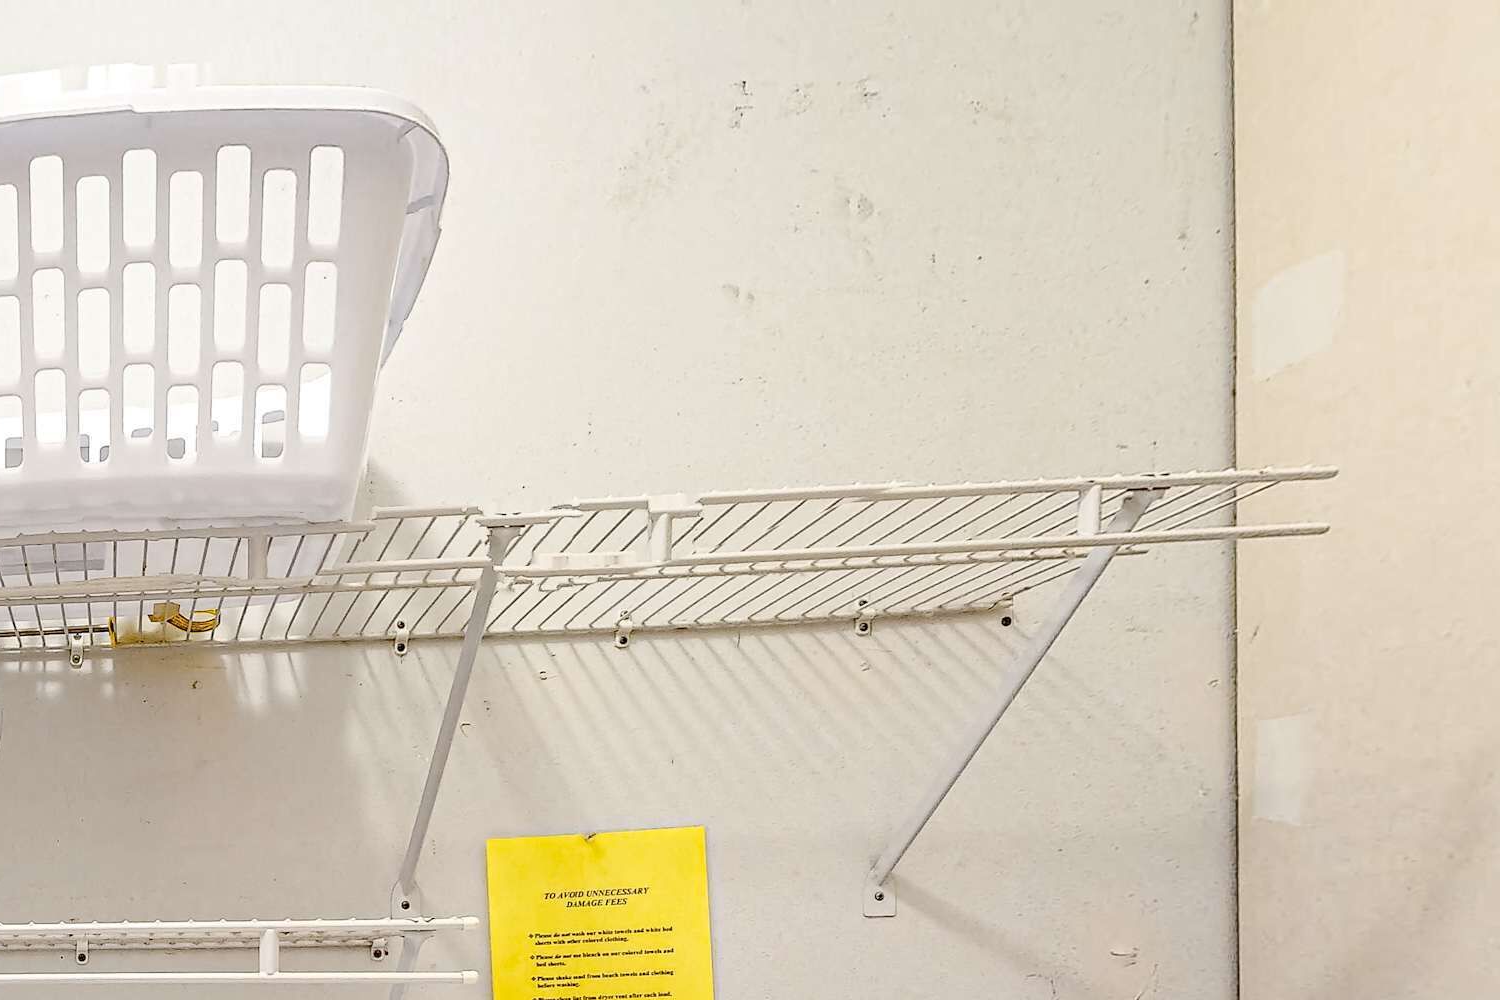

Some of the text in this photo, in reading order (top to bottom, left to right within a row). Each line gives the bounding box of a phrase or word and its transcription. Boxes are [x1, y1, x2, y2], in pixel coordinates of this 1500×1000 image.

[558, 890, 584, 899] AVOID
[586, 887, 649, 898] UNNECESSARY
[566, 898, 627, 908] DAMAGE FEES
